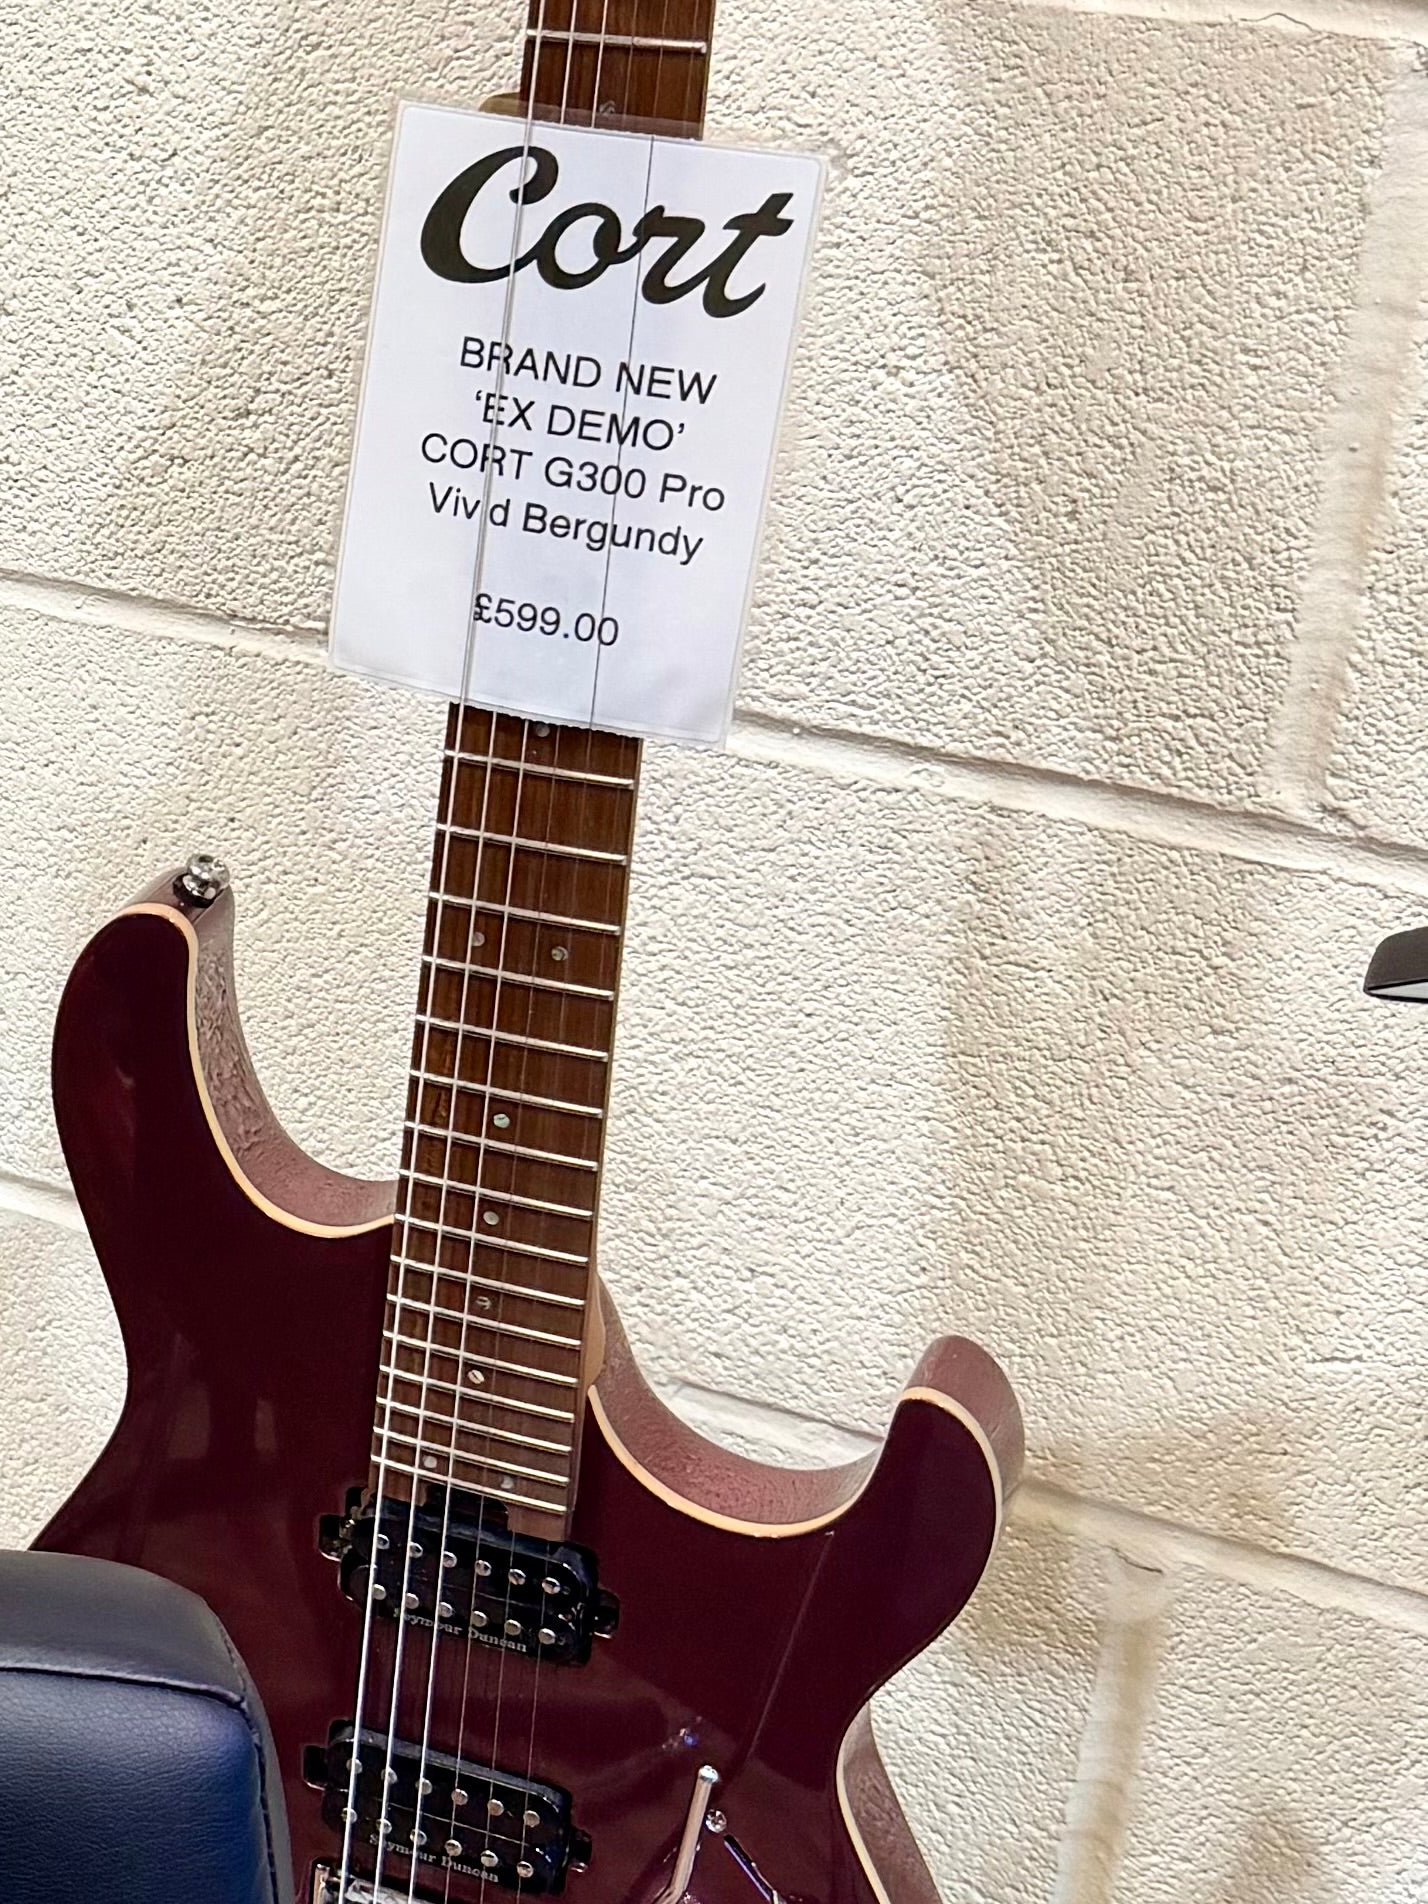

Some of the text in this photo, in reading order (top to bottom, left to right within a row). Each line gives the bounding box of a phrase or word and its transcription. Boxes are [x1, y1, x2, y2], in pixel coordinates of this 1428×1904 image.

[420, 145, 795, 319] Cort
[459, 336, 717, 405] BRAND NEW
[421, 432, 725, 512] CORT G300 Pro
[522, 502, 704, 567] Bergundy
[472, 593, 619, 648] £599.00
